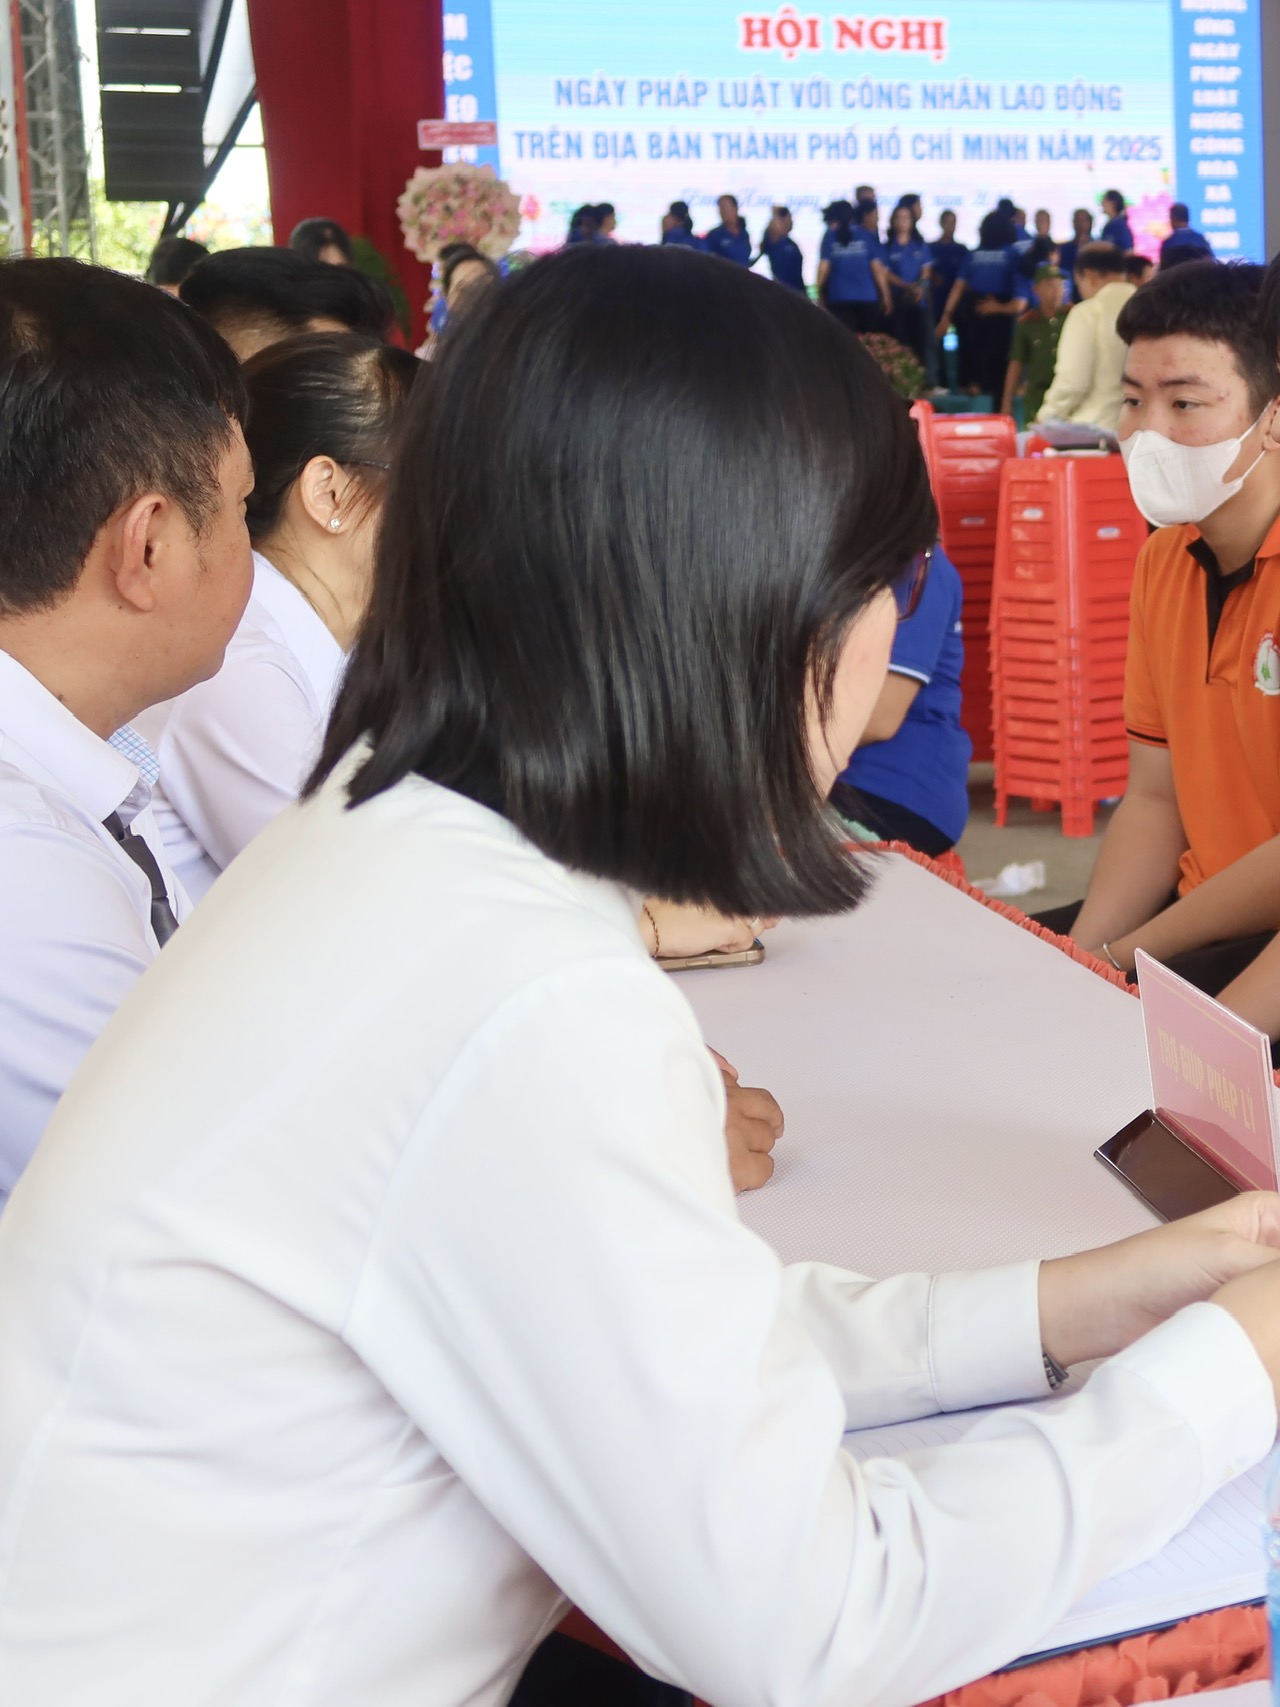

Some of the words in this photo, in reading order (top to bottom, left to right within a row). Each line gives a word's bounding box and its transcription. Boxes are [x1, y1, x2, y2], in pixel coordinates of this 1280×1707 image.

[742, 8, 820, 59] HỘI
[834, 19, 946, 62] NGHỊ
[554, 72, 626, 107] NGÀY
[638, 73, 708, 108] PHÁP
[719, 75, 780, 115] LUẬT
[790, 75, 832, 109] VỚI
[841, 76, 911, 110] CÔNG
[922, 77, 992, 111] NHÂN
[1001, 84, 1045, 111] LAO
[1055, 77, 1122, 118] ĐỘNG
[514, 126, 582, 159] TRÊN
[592, 131, 637, 166] ĐỊA
[648, 126, 702, 160] BÀN
[713, 126, 798, 160] THÀNH
[808, 124, 858, 160] PHỐ
[869, 125, 901, 160] HỒ
[911, 126, 951, 160] CHÍ
[963, 134, 1028, 160] MINH
[1039, 128, 1094, 160] NĂM
[1104, 135, 1161, 161] 2025
